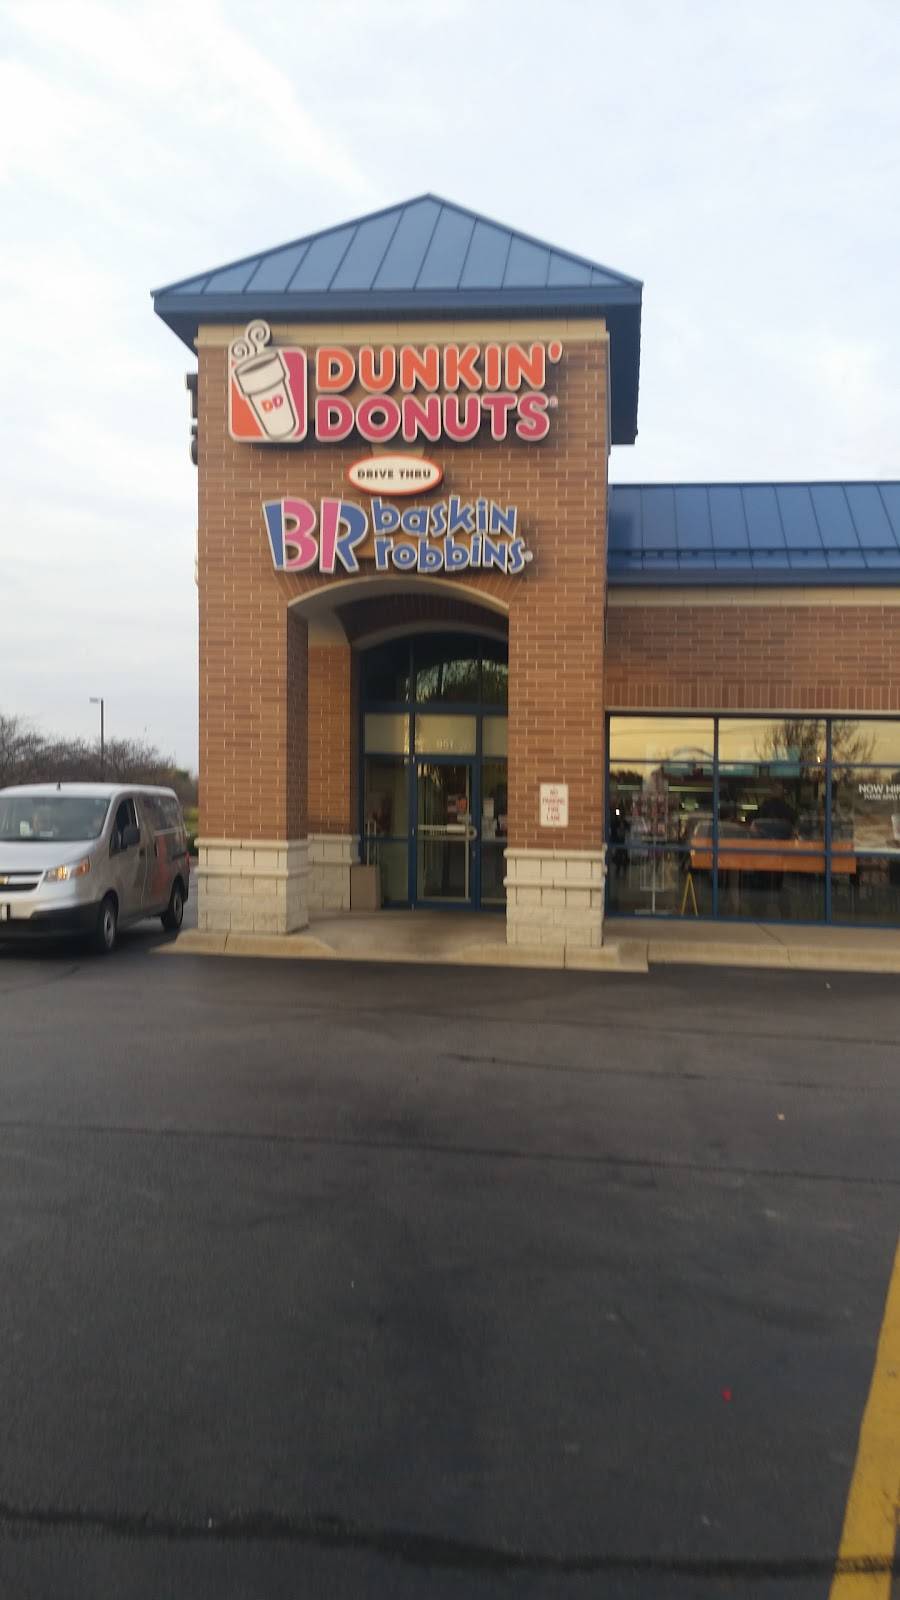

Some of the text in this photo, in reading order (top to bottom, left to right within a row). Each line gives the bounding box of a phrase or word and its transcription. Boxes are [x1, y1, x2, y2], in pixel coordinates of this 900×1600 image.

[316, 341, 562, 392] DUNKIN'
[261, 394, 284, 412] DD
[315, 391, 550, 443] DONUTS
[357, 467, 431, 479] DRIVE THRU
[262, 496, 368, 573] BR
[371, 495, 517, 540] baskin
[374, 533, 526, 575] robbins
[858, 784, 883, 793] NOW
